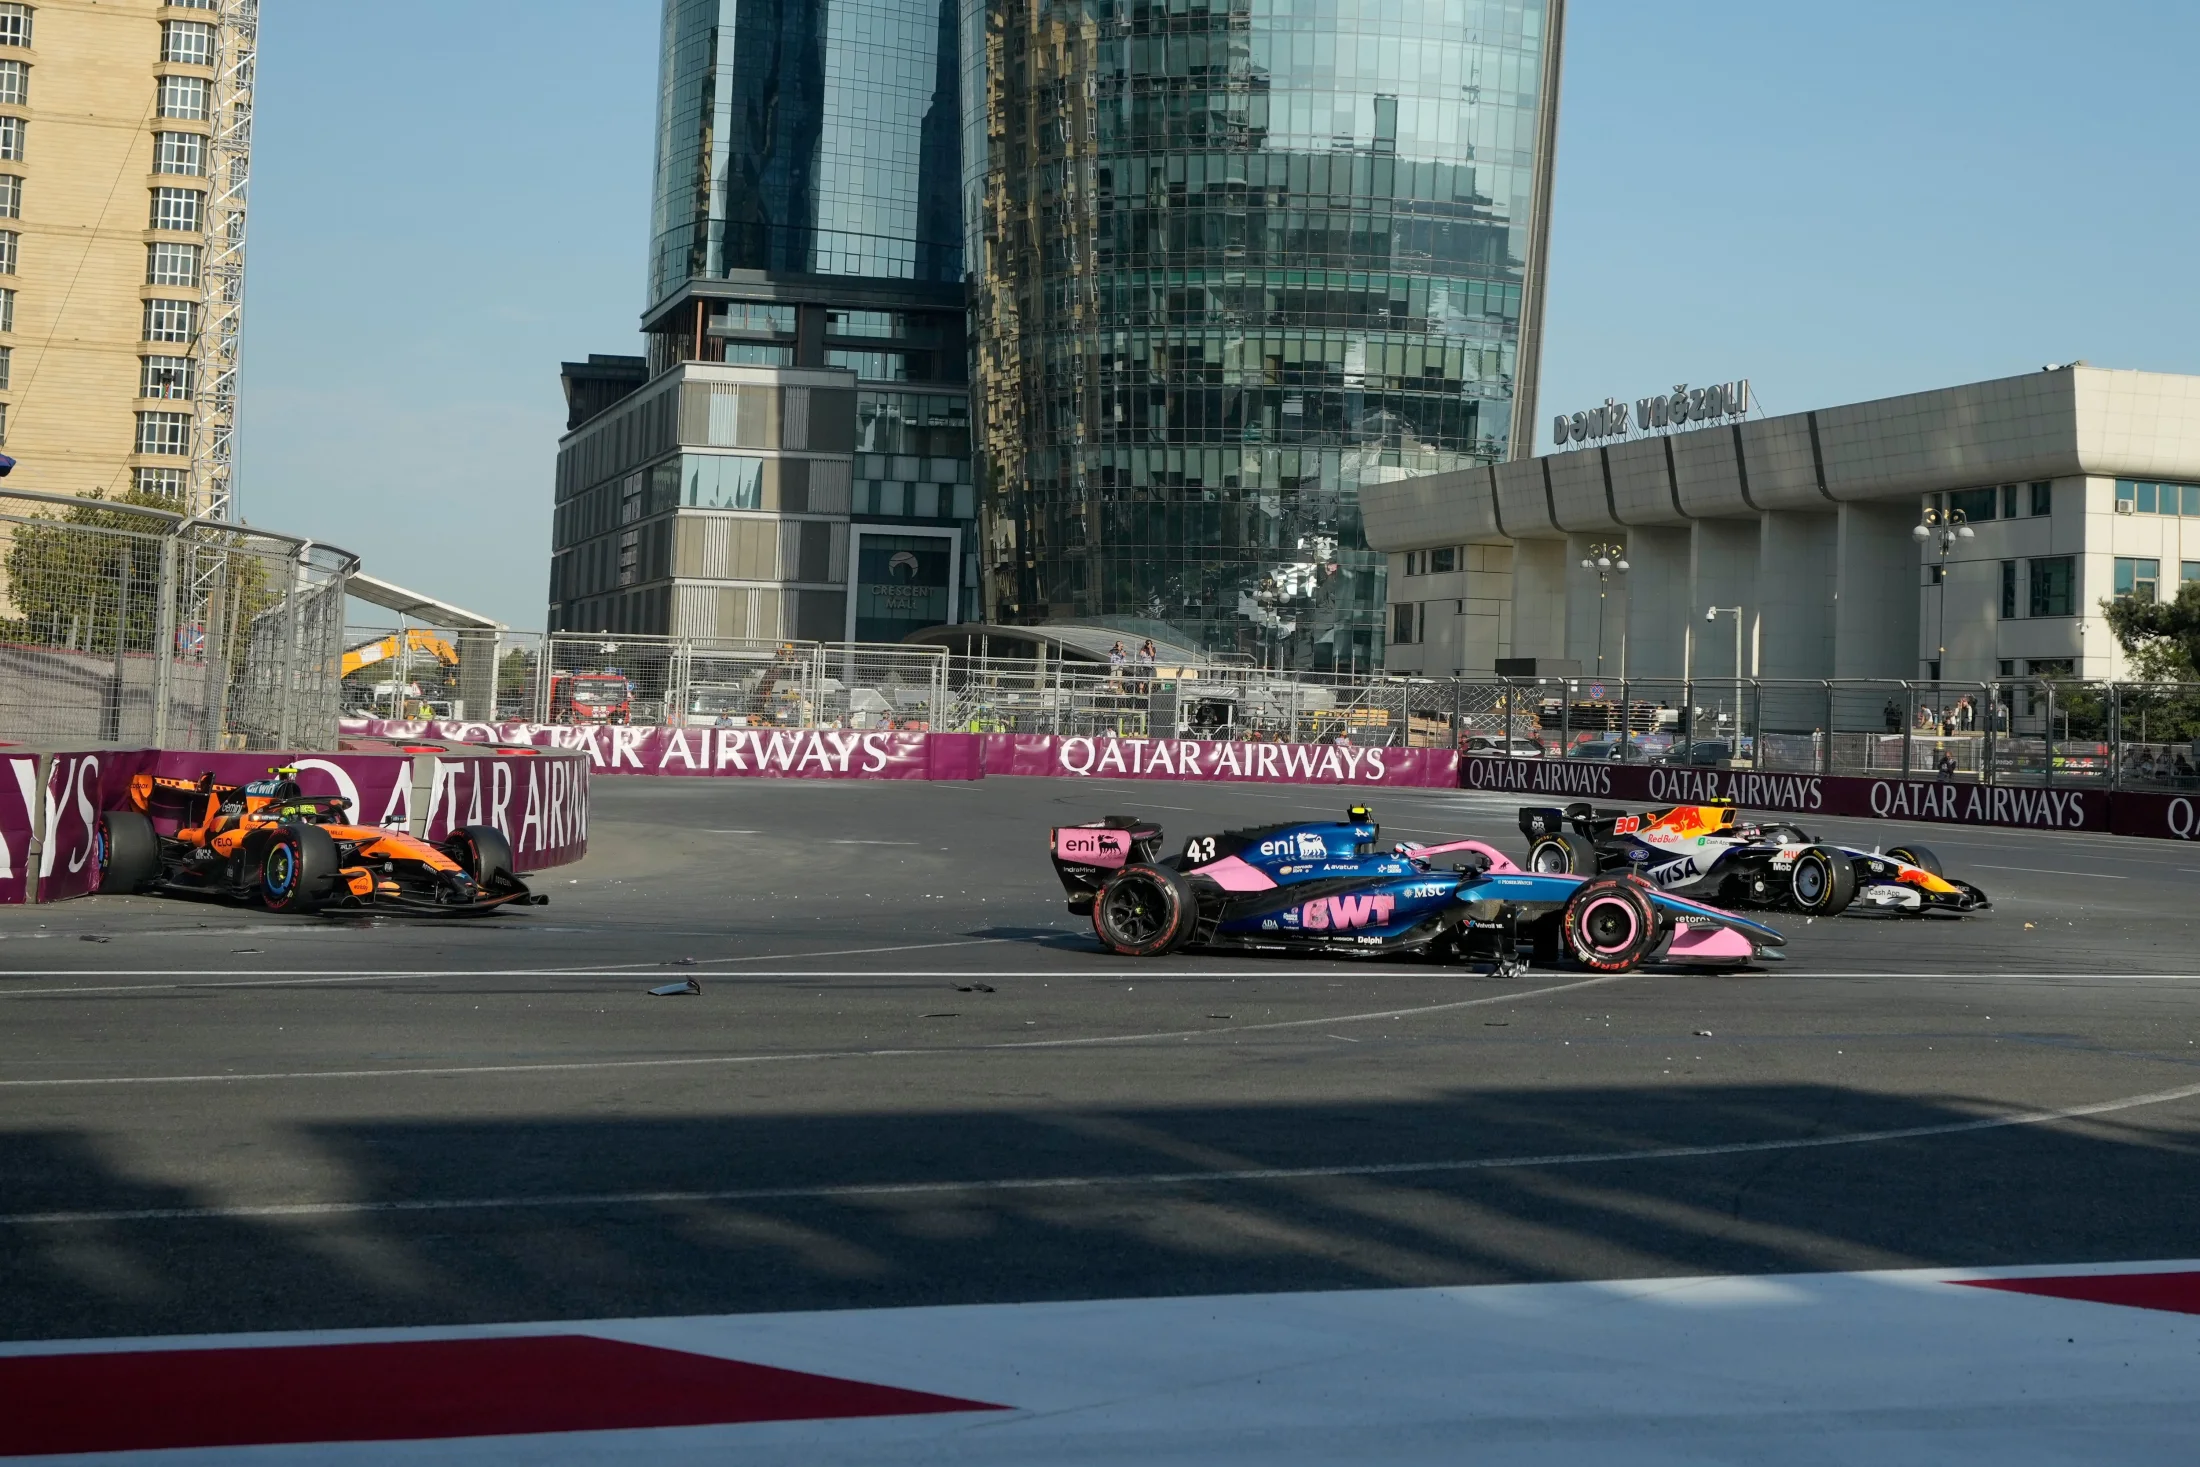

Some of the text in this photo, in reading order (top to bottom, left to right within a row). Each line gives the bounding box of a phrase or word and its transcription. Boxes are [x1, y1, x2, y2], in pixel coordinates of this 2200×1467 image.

[1553, 378, 1748, 445] DƏNİZ VAĞZALI
[871, 584, 934, 597] CRESCENT
[885, 598, 918, 610] MALL
[659, 728, 889, 773] AIRWAYS
[1061, 737, 1385, 780] QATAR AIRWAYS
[1469, 759, 1611, 795] QATAR AIRWAYS
[1649, 768, 1822, 809] QATAR AIRWAYS
[221, 801, 243, 815] Gemini
[1870, 781, 2085, 828] QATAR AIRWAYS
[1613, 816, 1641, 835] 30
[2167, 797, 2200, 839] Q
[1065, 836, 1095, 852] eni
[1187, 837, 1215, 863] 43
[1260, 835, 1295, 856] eni
[1783, 851, 1799, 859] HU
[1654, 857, 1702, 886] VISA
[1772, 862, 1792, 872] Mob
[1414, 886, 1446, 898] MSC
[1303, 895, 1395, 929] BWT
[1357, 936, 1382, 945] Delphi
